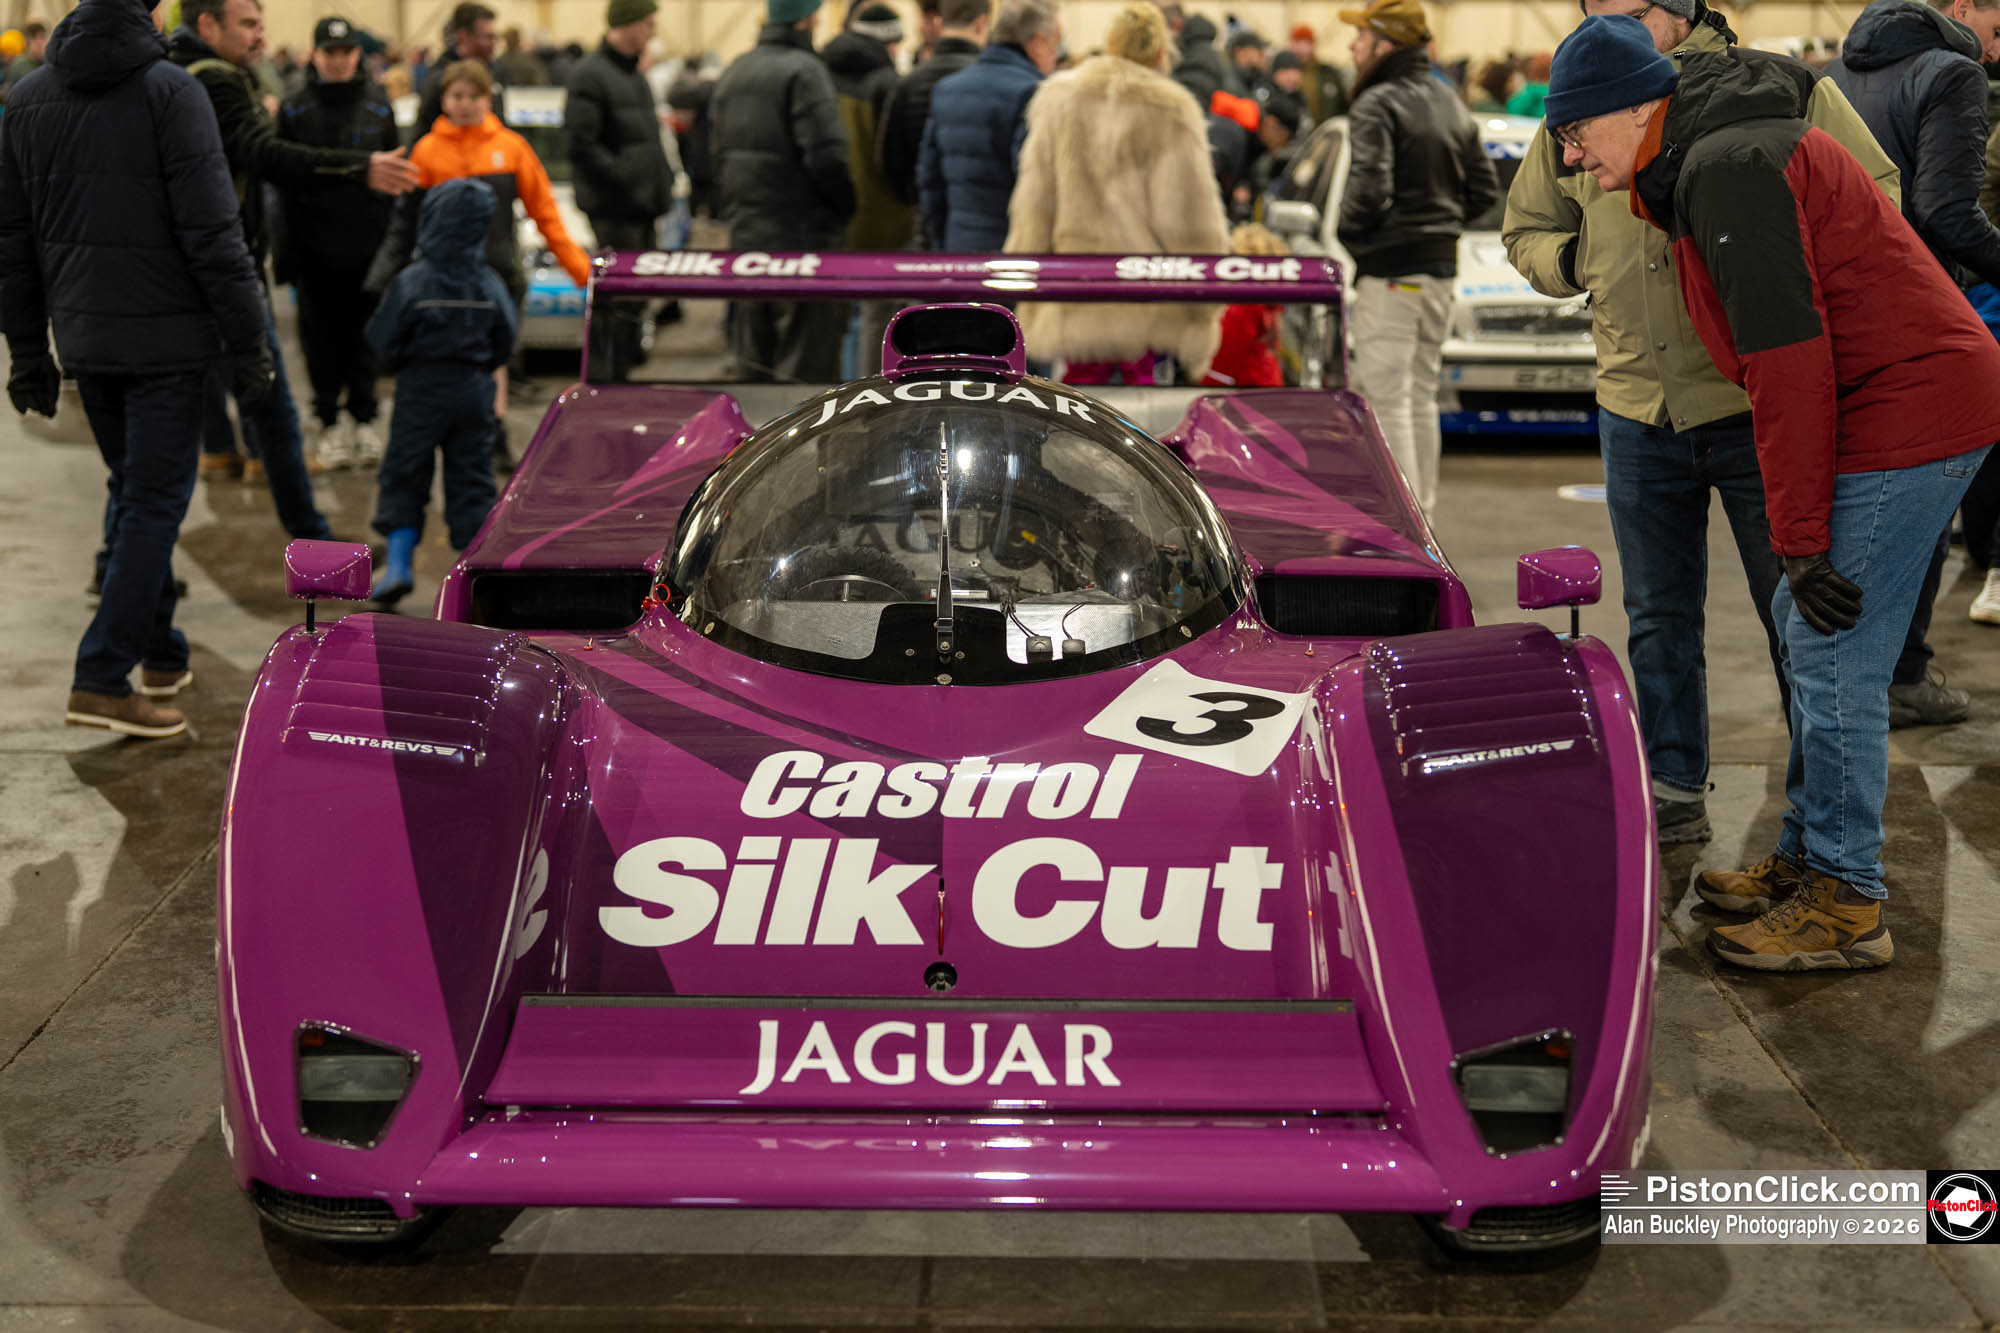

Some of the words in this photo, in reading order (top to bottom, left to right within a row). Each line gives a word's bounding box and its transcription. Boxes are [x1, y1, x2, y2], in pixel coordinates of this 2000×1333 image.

[632, 252, 725, 275] Silk
[732, 253, 821, 276] Cut
[1115, 257, 1206, 280] Silk
[1214, 257, 1302, 281] Cut
[810, 380, 1097, 429] JAGUAR
[1136, 691, 1286, 747] 3
[328, 734, 434, 754] ART&REVS
[1447, 742, 1553, 766] ART&REVS
[741, 751, 1143, 820] Castrol
[599, 836, 936, 947] Silk
[972, 837, 1284, 951] Cut
[740, 1020, 1122, 1095] JAGUAR
